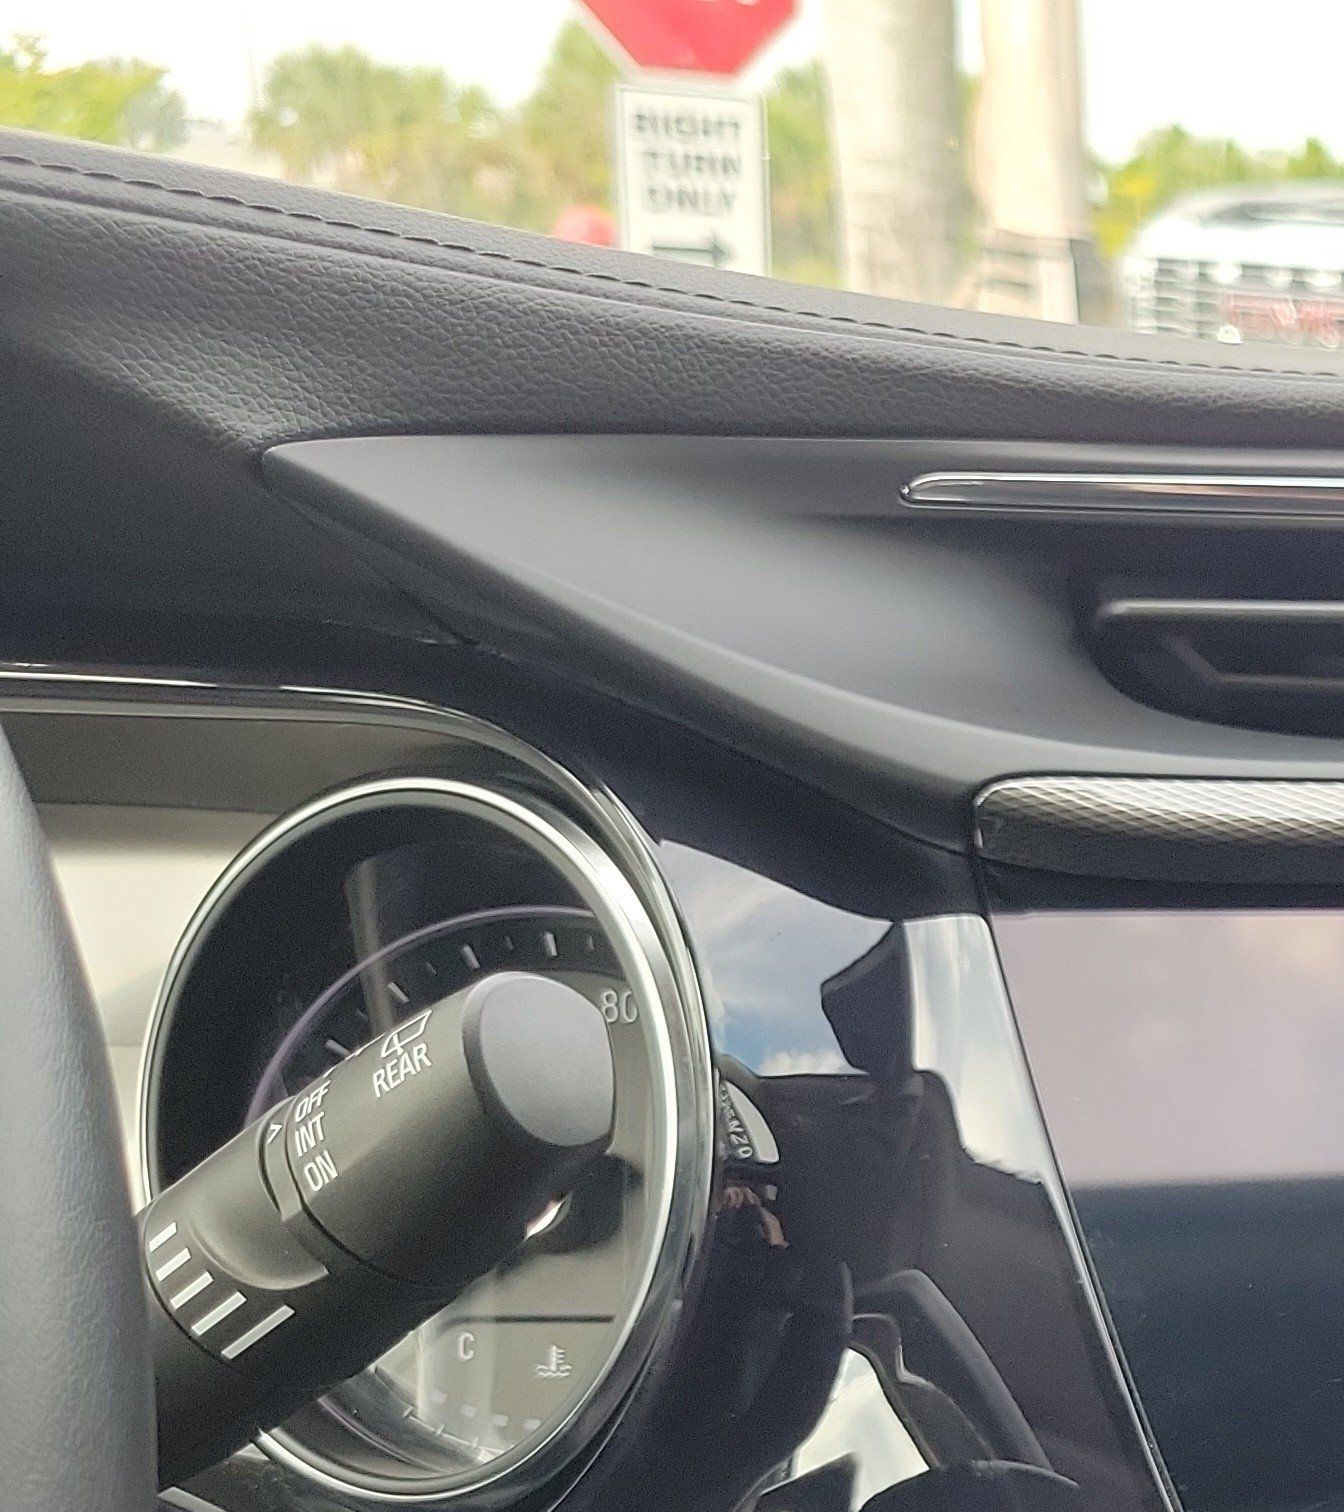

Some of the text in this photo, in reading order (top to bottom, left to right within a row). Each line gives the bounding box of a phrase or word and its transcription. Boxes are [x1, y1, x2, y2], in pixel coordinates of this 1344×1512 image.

[372, 1042, 433, 1099] REAR
[294, 1080, 331, 1123] OFF
[294, 1111, 326, 1158] INT
[303, 1149, 339, 1192] ON
[458, 1332, 475, 1361] C
